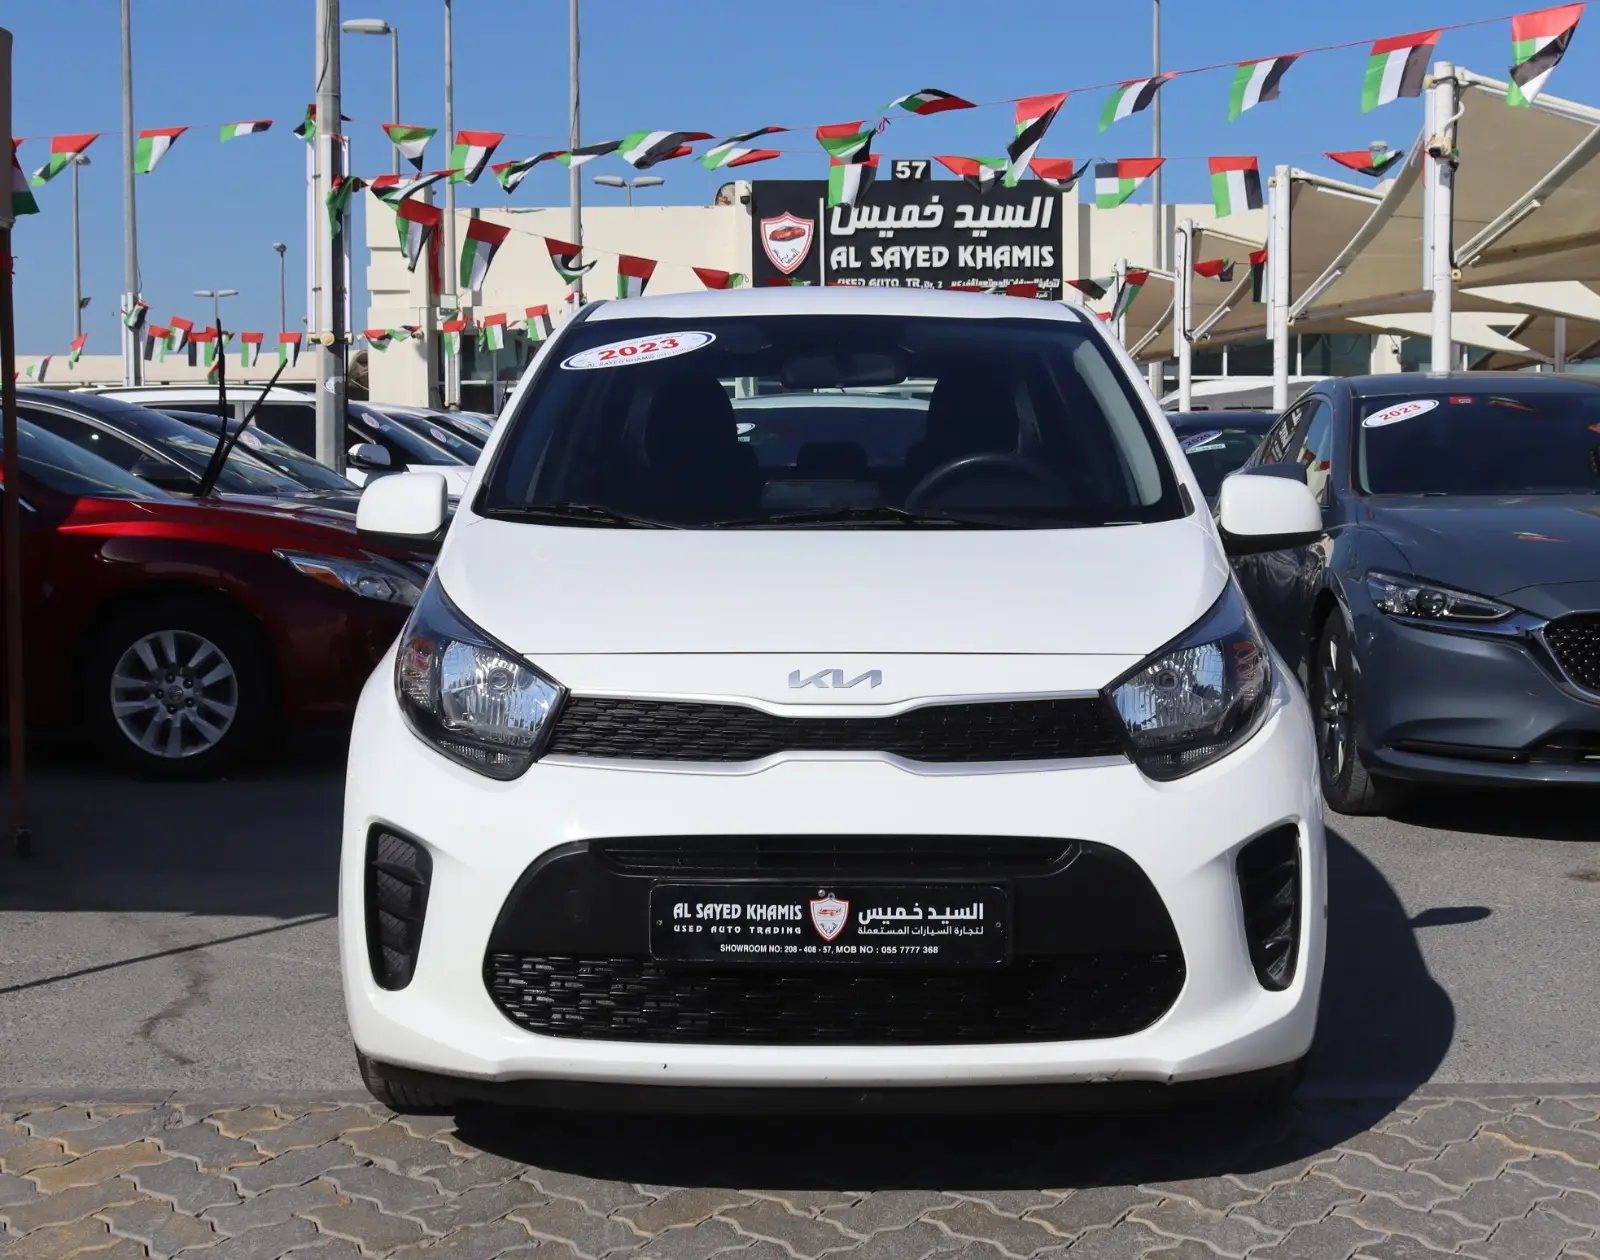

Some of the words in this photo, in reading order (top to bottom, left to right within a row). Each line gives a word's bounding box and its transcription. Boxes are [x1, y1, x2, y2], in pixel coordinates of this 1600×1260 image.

[895, 161, 927, 179] 57
[829, 195, 944, 238] خميس
[954, 196, 1055, 238] السيد
[830, 246, 862, 271] AL
[870, 246, 949, 271] SAYED
[958, 246, 1055, 270] KHAMIS
[597, 338, 680, 361] 2023
[1379, 404, 1421, 421] 2023
[788, 669, 882, 688] KIA
[673, 903, 691, 919] AL
[696, 903, 742, 920] SAYED
[746, 904, 802, 921] KHAMIS
[858, 902, 923, 925] خميس
[927, 902, 984, 925] السيد
[673, 925, 703, 933] USED
[711, 926, 741, 934] AUTO
[749, 926, 802, 935] TRADING
[857, 925, 909, 935] المستعملة
[911, 925, 952, 937] السيارات
[953, 926, 984, 937] لتجارة
[720, 944, 767, 953] SHOWROOM
[768, 944, 783, 953] NO:
[784, 945, 798, 953] 208
[804, 946, 817, 954] 408
[823, 946, 834, 955] 57,
[836, 946, 857, 954] MOB
[860, 946, 874, 954] NO
[881, 946, 897, 954] 055
[900, 946, 921, 954] 7777
[922, 946, 939, 954] 368
